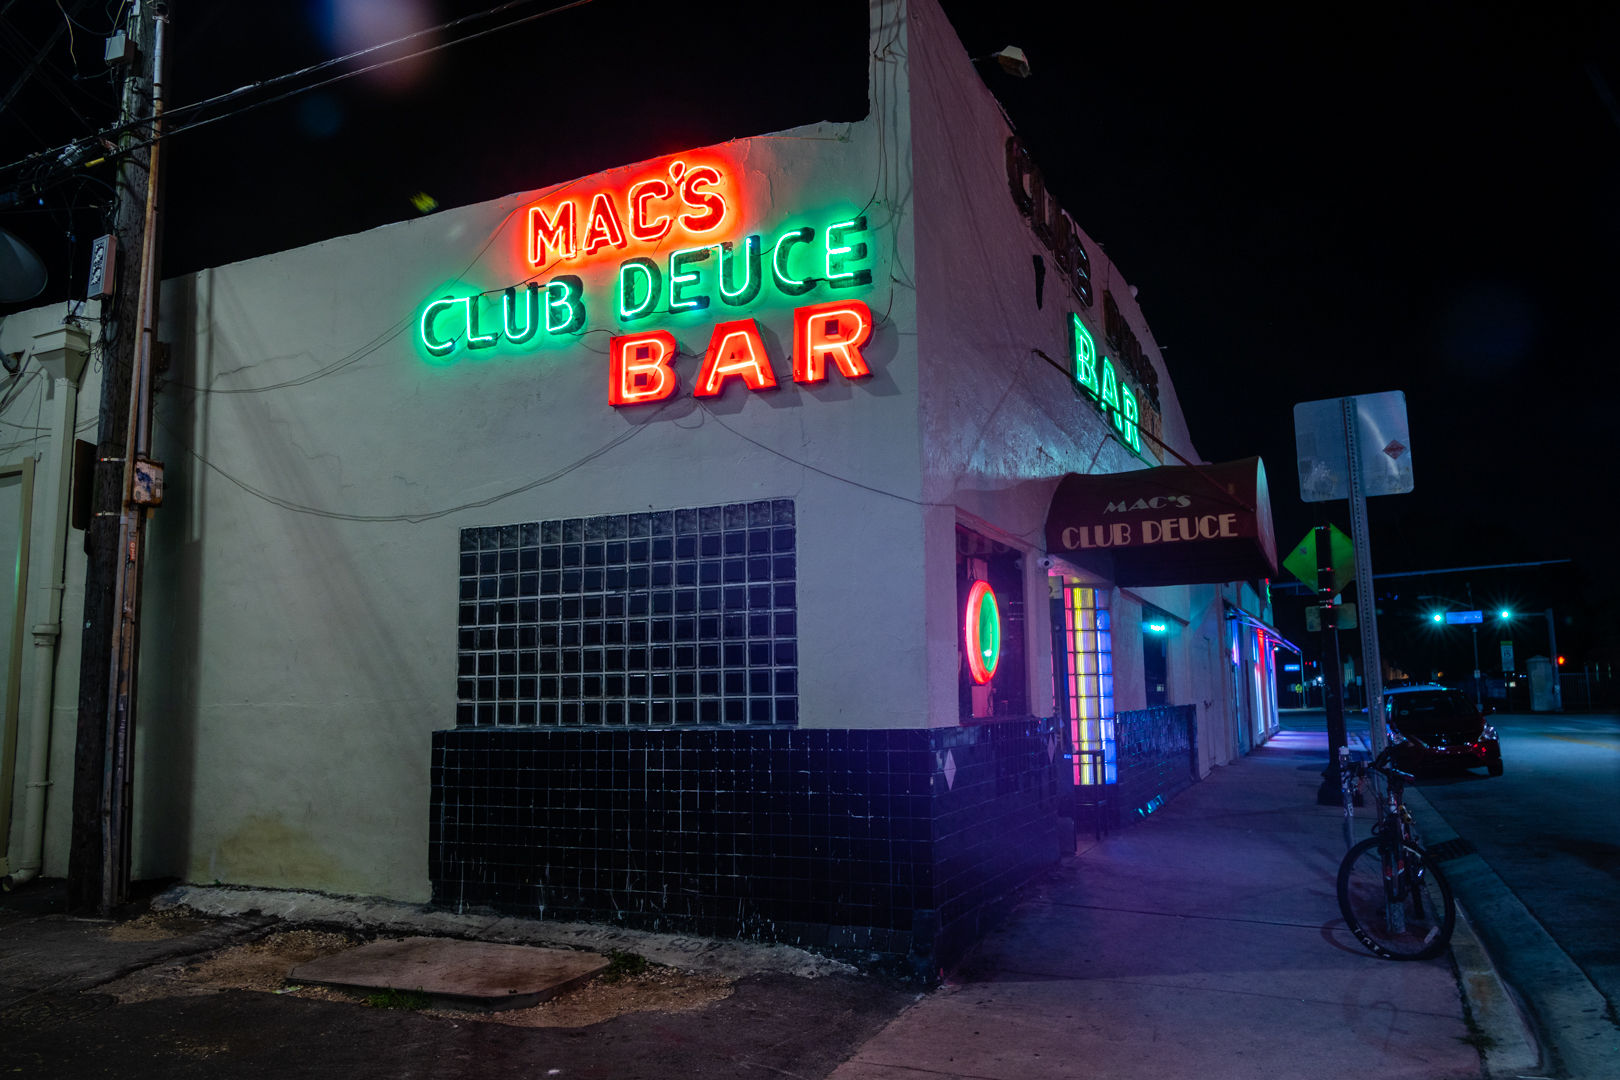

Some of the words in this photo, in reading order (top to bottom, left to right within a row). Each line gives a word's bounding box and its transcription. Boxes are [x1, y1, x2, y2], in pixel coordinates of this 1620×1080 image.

[527, 160, 727, 267] MAC'S
[420, 274, 587, 357] CLUB
[618, 215, 873, 322] DEUCE
[608, 299, 875, 407] BAR
[1067, 311, 1142, 455] BAR
[1061, 522, 1132, 550] CLUB
[1141, 512, 1239, 545] DEUCE
[1103, 495, 1192, 514] MAC'S
